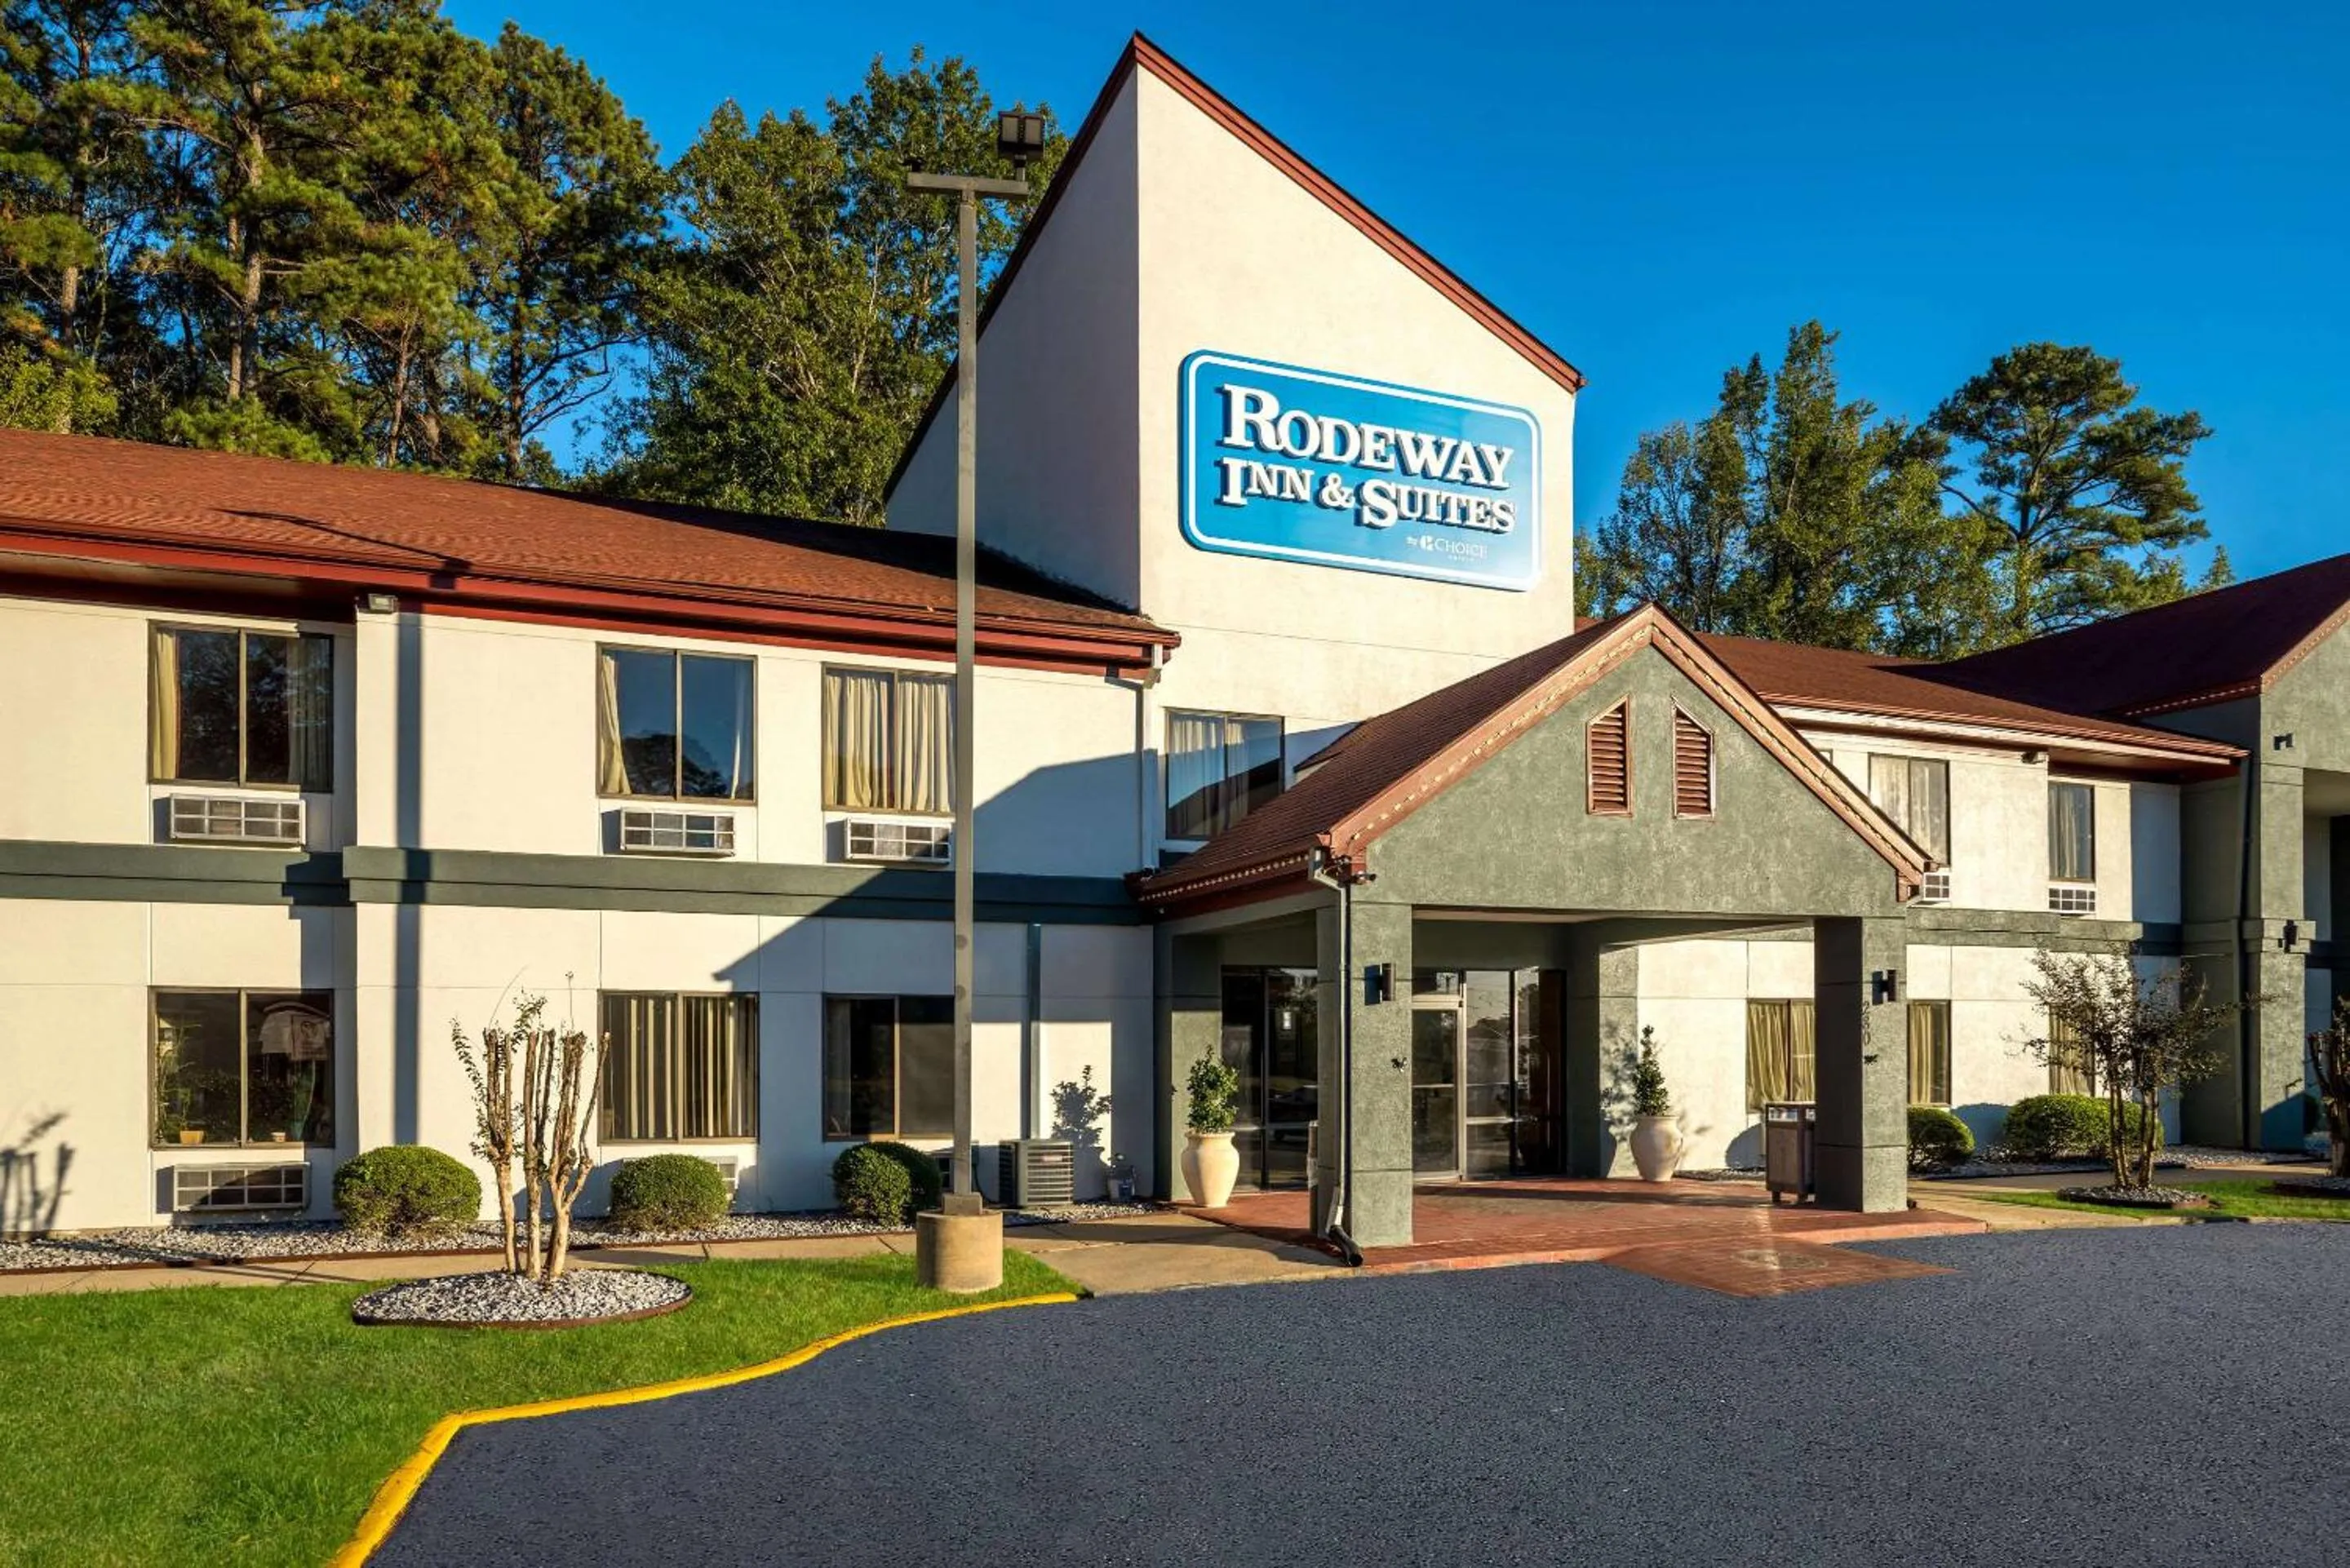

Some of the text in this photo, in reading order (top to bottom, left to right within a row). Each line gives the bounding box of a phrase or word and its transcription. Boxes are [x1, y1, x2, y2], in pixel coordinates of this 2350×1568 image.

[1220, 383, 1514, 489] RODEWAY
[1218, 457, 1515, 533] INN & SUITES
